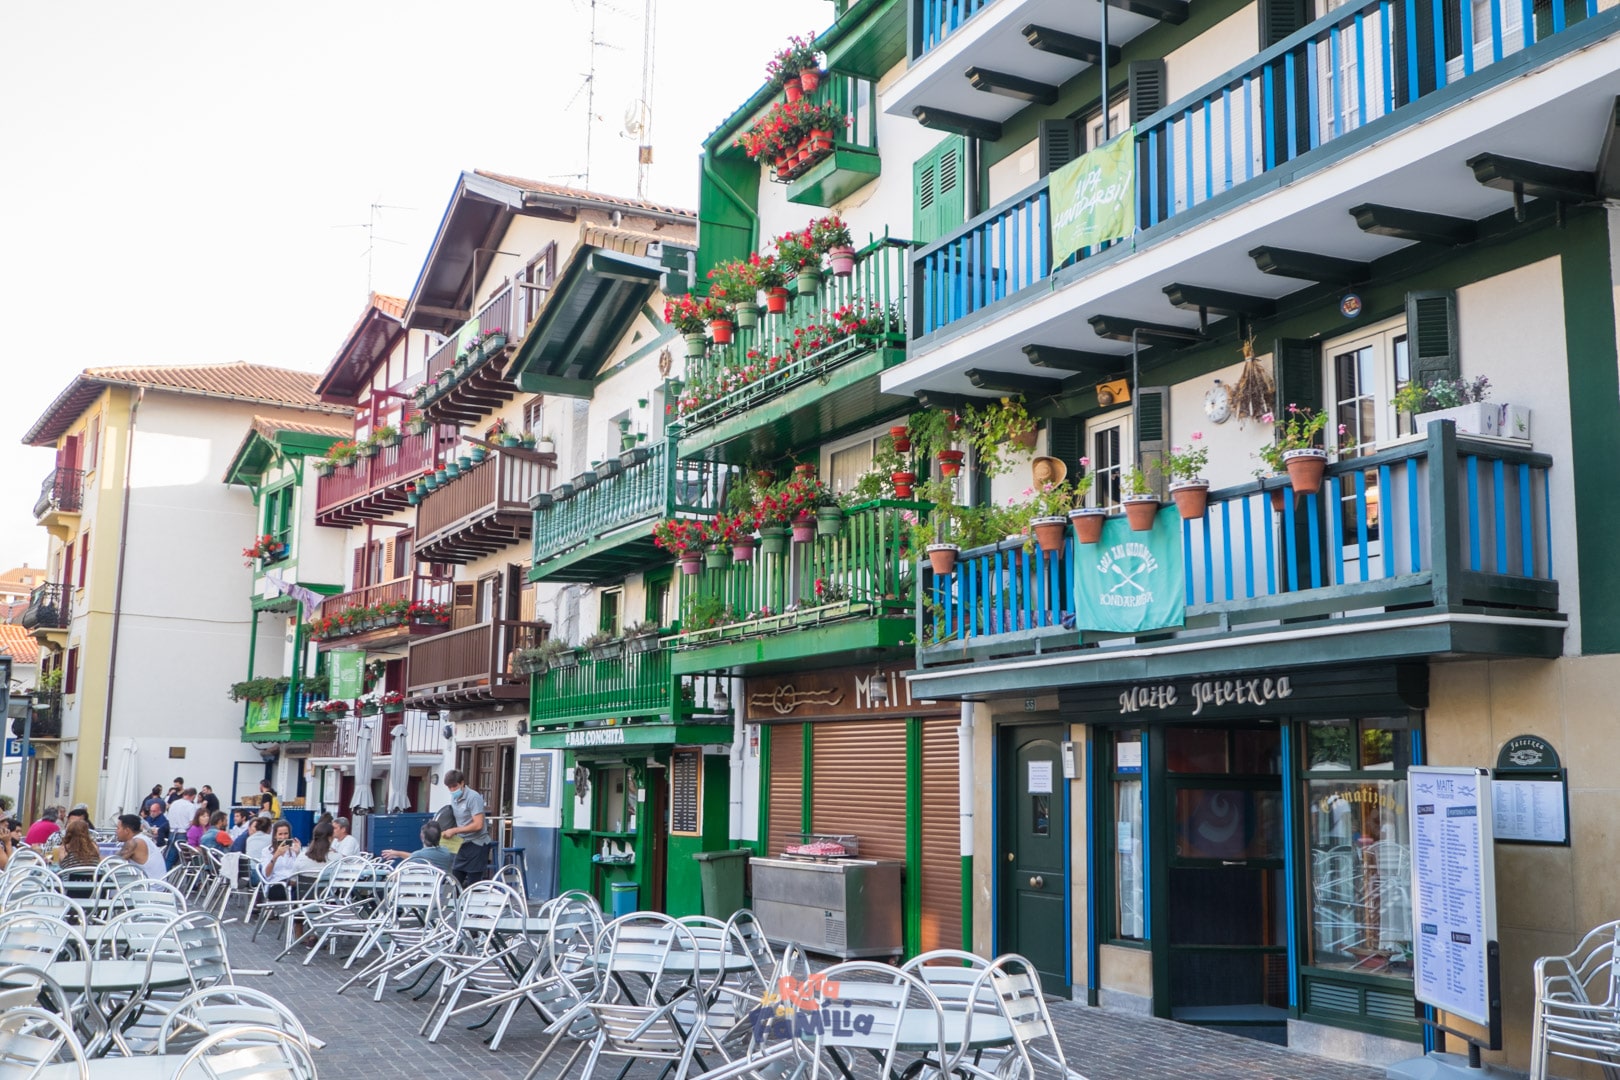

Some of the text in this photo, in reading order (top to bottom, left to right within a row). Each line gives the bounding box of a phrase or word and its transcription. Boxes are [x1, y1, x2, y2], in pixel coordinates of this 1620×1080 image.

[1119, 676, 1292, 716] Maite Jatetxea
[570, 727, 625, 746] BAR CONCHITA
